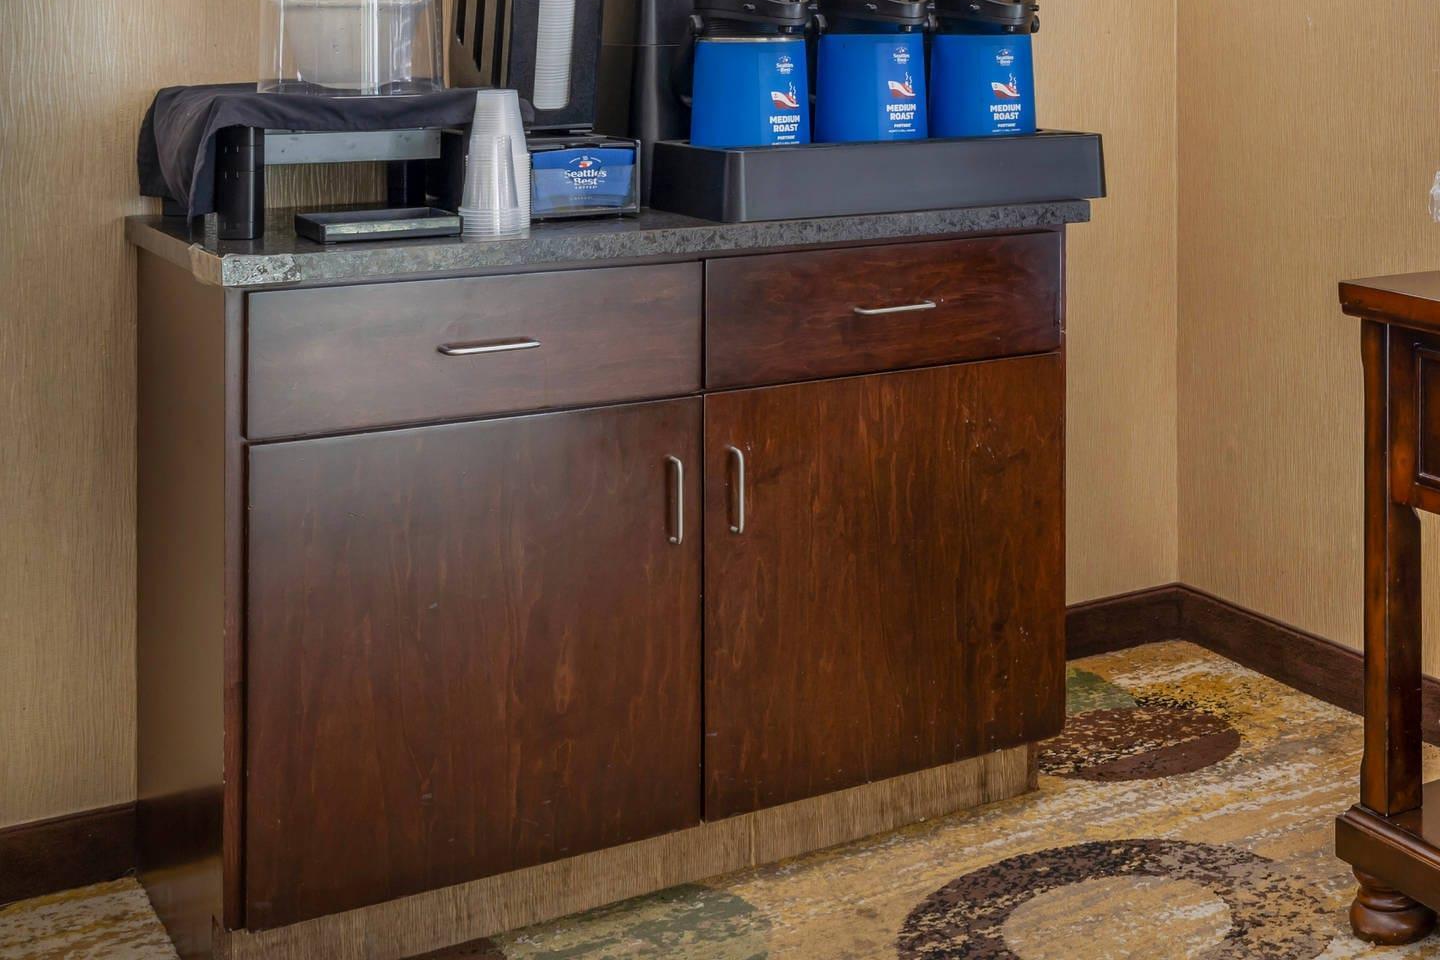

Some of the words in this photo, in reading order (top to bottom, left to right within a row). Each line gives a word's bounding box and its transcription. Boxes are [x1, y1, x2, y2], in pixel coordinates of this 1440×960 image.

[886, 103, 916, 113] MEDIUM
[990, 103, 1021, 113] MEDIUM
[769, 115, 800, 125] MEDIUM
[890, 112, 914, 121] ROAST
[993, 112, 1019, 121] ROAST
[773, 123, 799, 133] ROAST
[573, 177, 598, 186] Best
